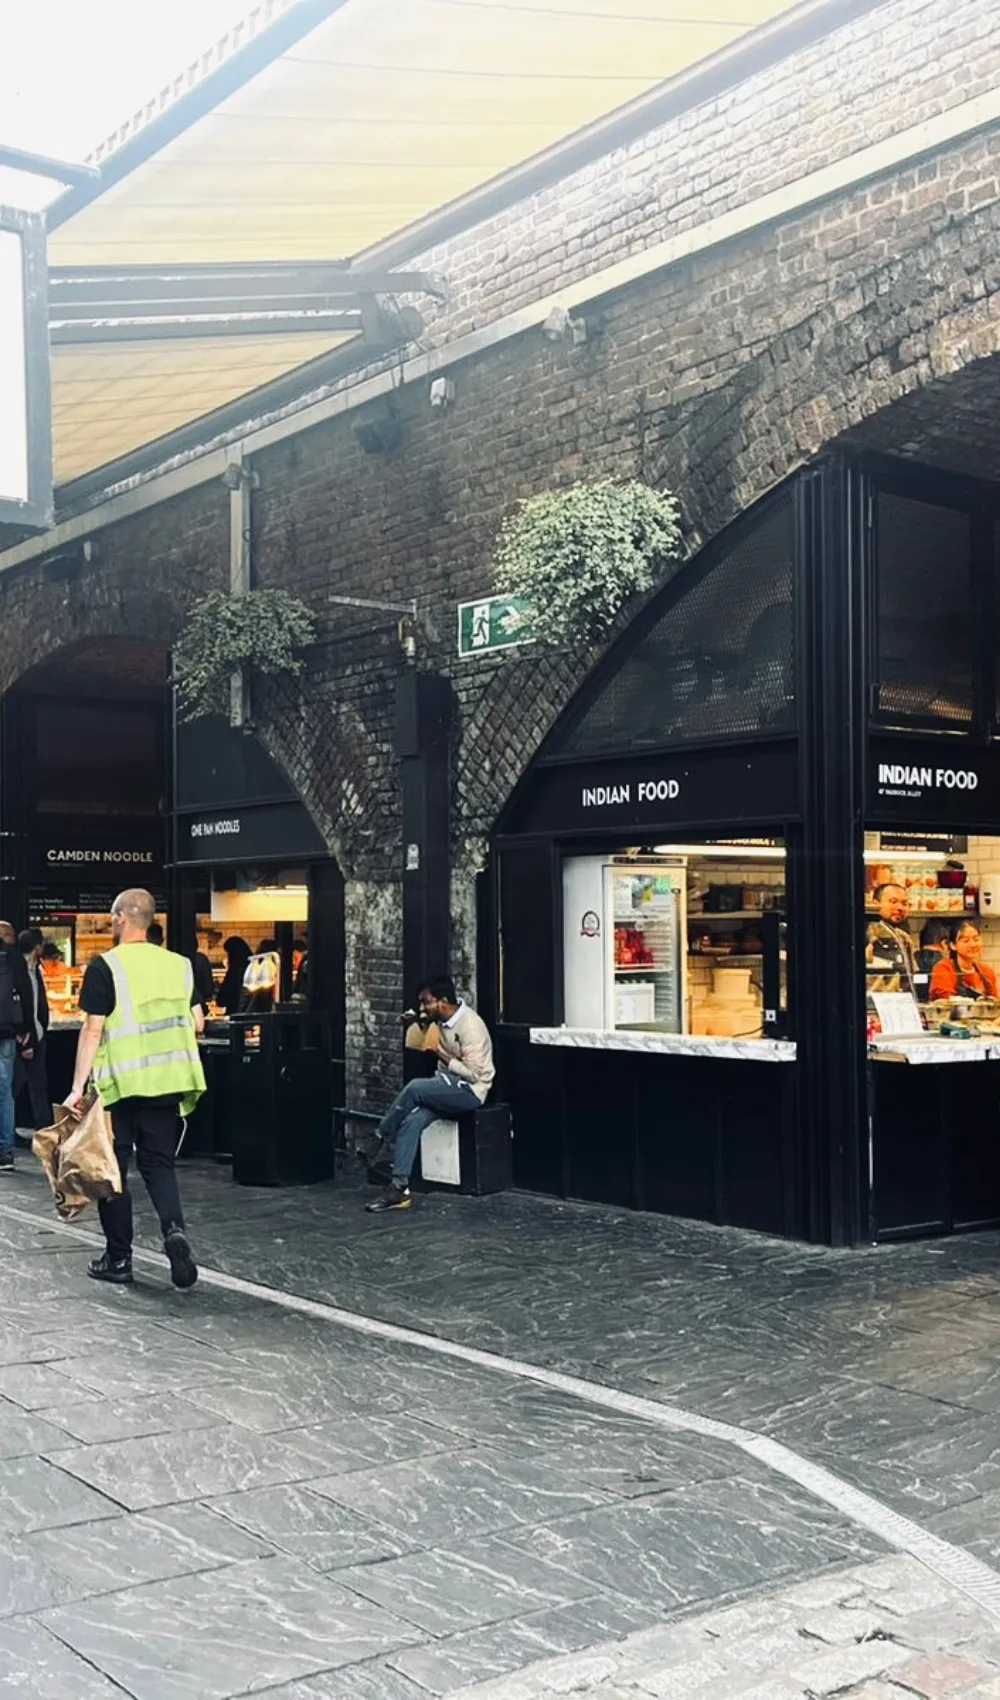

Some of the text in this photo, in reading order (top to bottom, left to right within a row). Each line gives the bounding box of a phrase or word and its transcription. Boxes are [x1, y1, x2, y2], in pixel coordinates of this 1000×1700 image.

[879, 764, 978, 789] INDIAN FOOD
[582, 780, 679, 806] INDIAN FOOD
[47, 849, 153, 862] CAMDEN NOODLE
